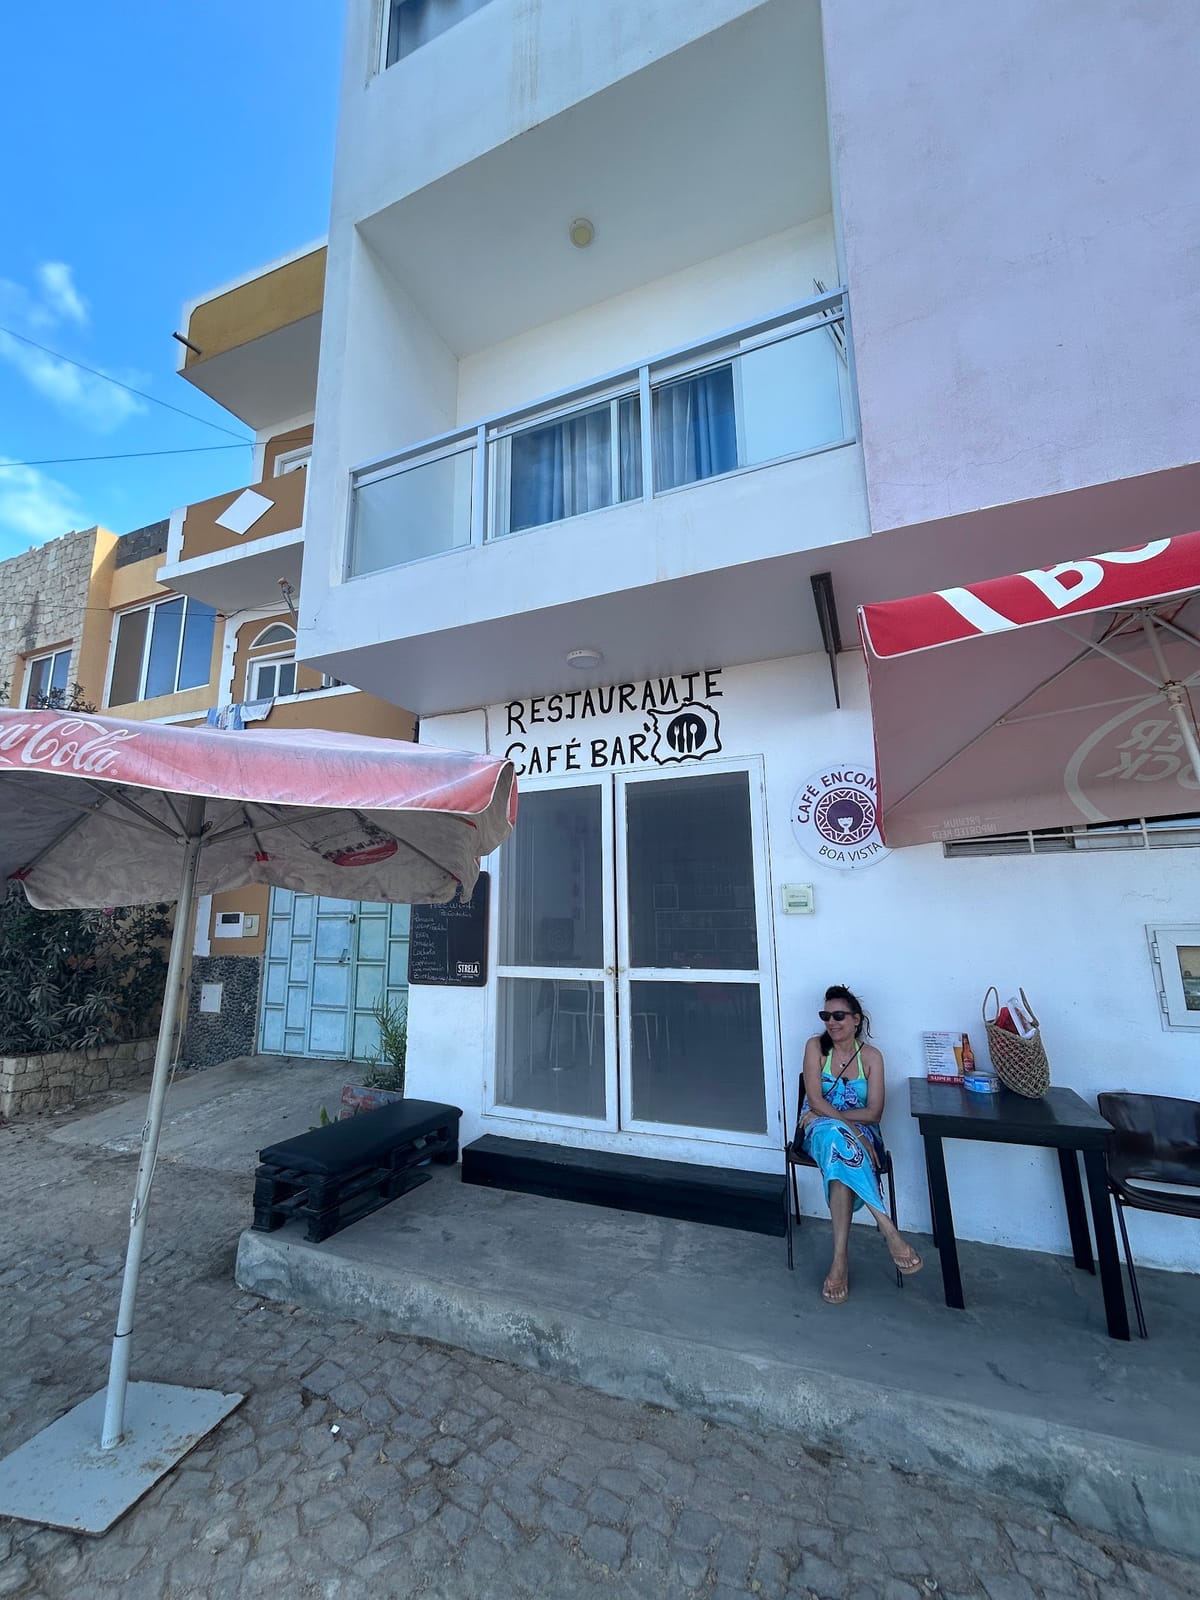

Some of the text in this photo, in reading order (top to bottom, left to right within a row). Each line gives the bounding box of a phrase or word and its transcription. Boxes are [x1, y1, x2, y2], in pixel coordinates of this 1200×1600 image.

[504, 668, 724, 736] RESTAURANTE
[504, 733, 649, 776] CAFÉ BAR
[797, 770, 877, 824] CAFÉ ENCON
[818, 841, 883, 862] BOA VISTA
[457, 963, 479, 974] STRELA
